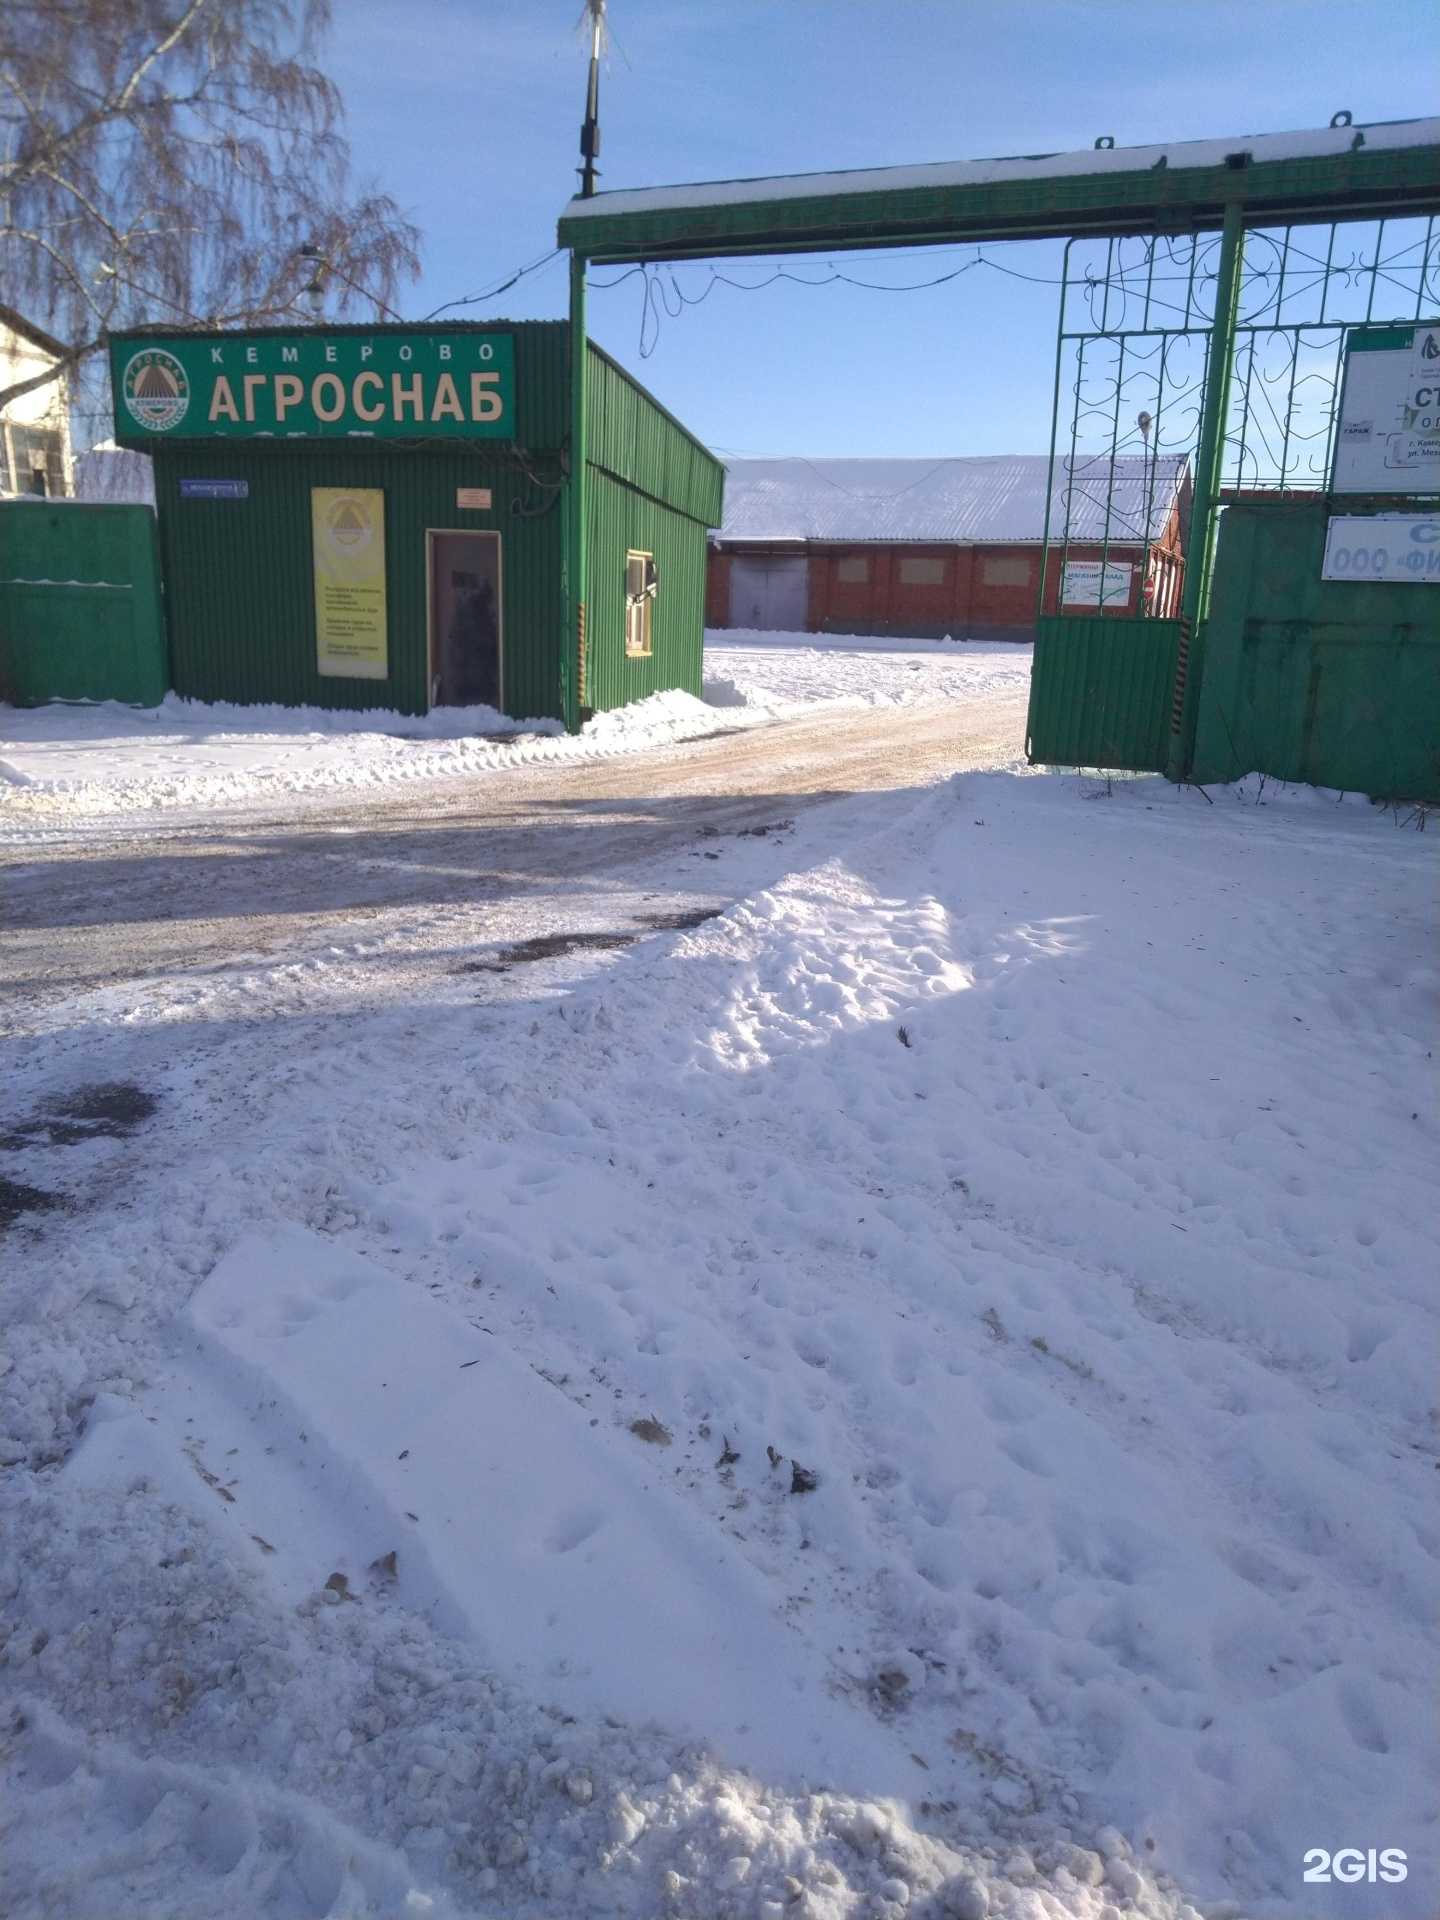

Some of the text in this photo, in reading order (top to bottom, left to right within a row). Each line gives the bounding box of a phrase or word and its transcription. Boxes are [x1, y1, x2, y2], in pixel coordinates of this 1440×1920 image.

[210, 344, 494, 364] КЕМЕРОВО
[207, 371, 504, 423] АГРОСНАБ
[1334, 547, 1388, 573] ООО
